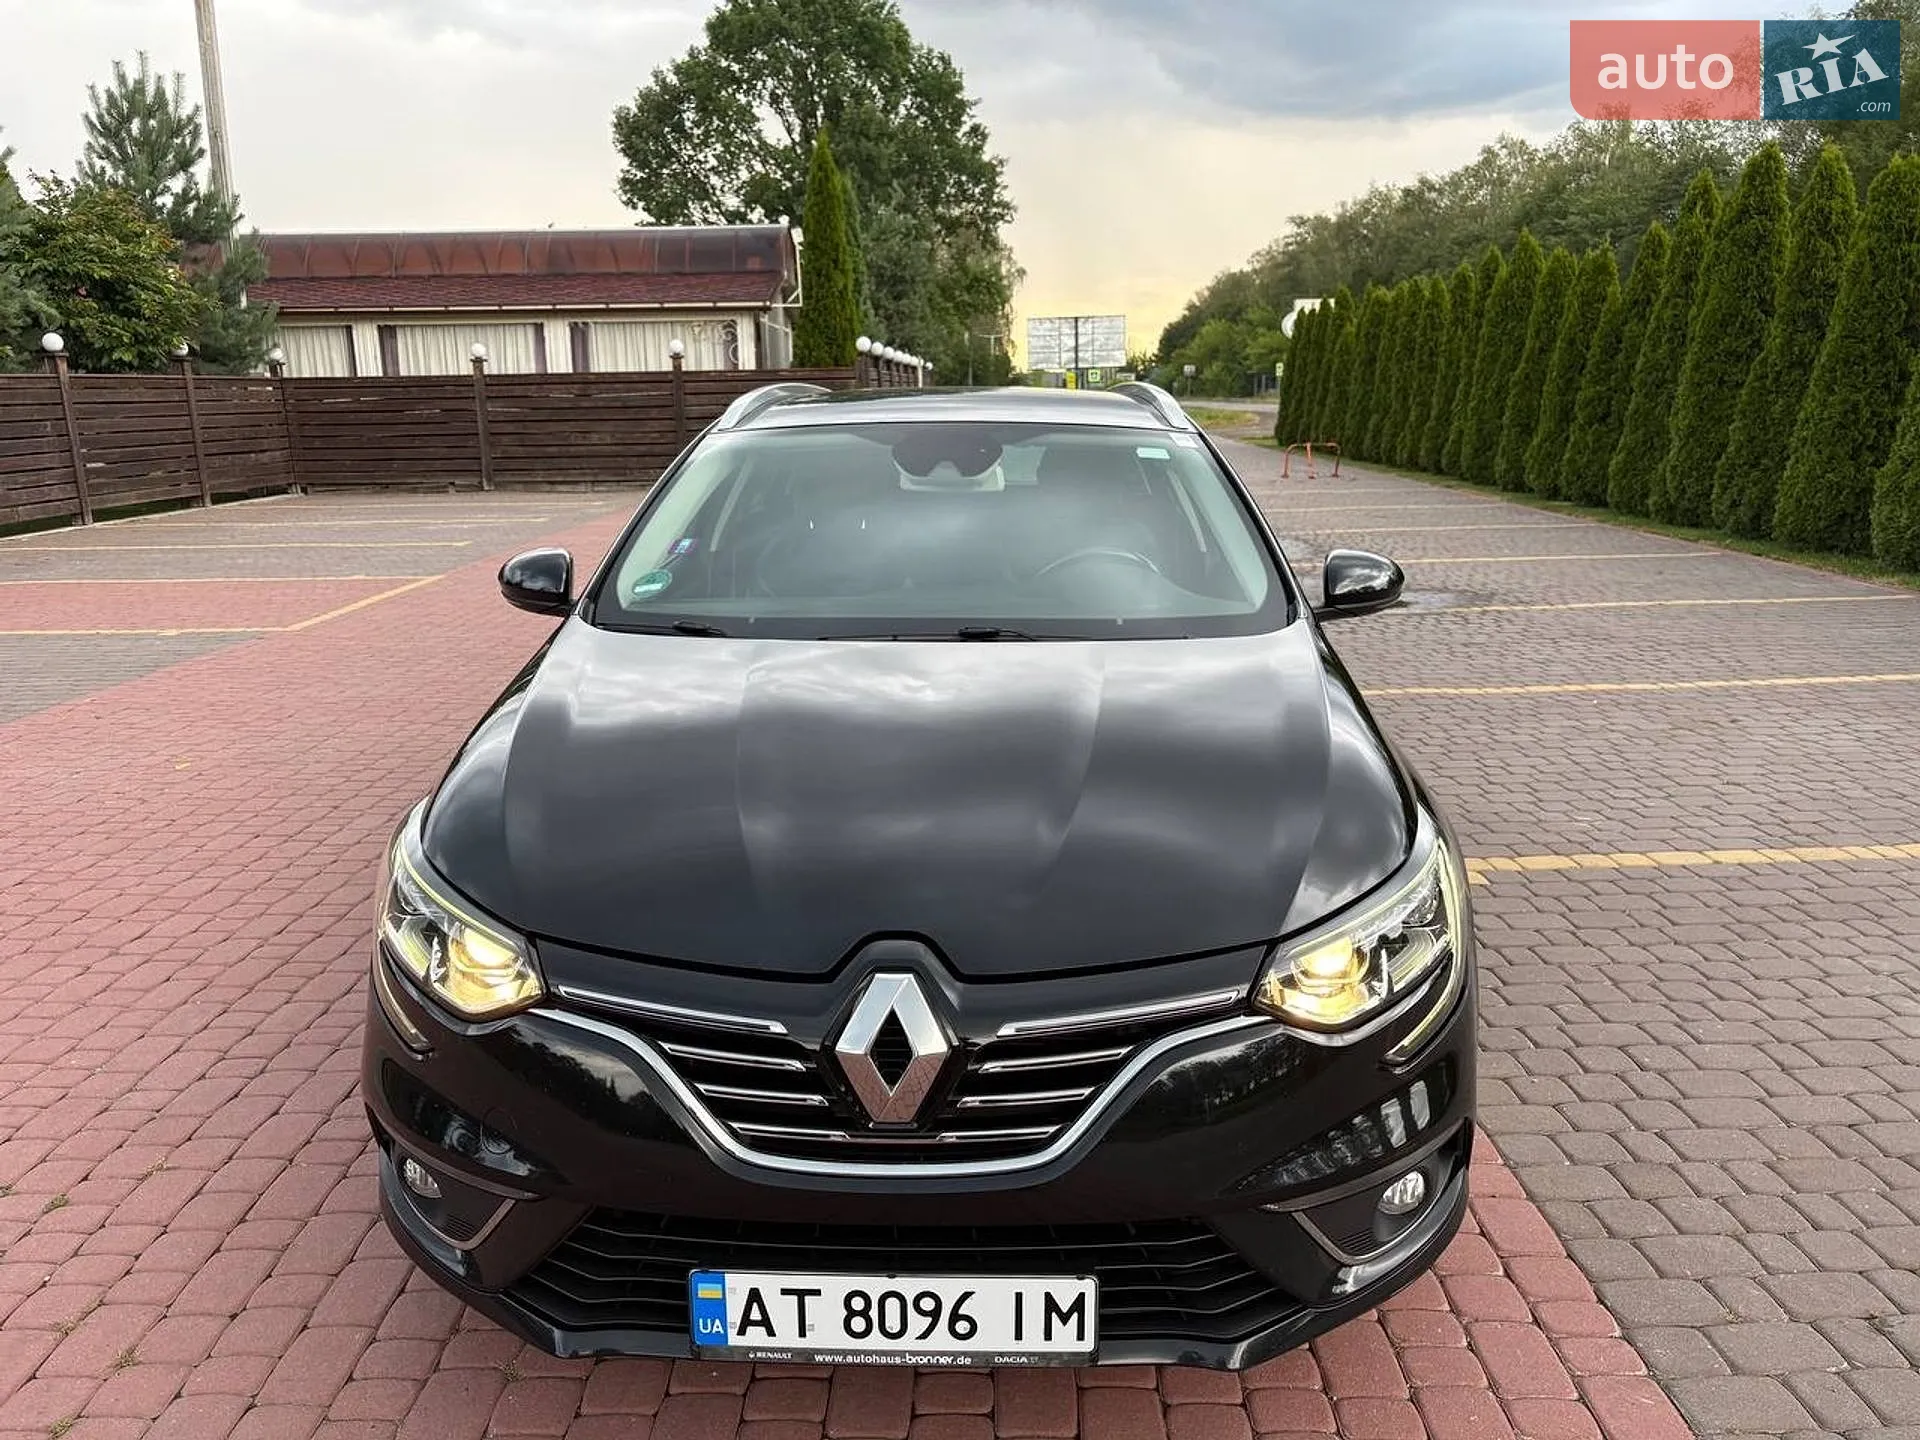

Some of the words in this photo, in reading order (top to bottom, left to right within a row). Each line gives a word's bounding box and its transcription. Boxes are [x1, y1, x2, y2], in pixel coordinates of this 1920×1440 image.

[736, 1287, 822, 1339] AT
[842, 1289, 979, 1342] 8096
[1014, 1291, 1086, 1342] IM
[699, 1318, 724, 1334] UA
[756, 1351, 792, 1359] RENAULT
[814, 1352, 972, 1366] www.autohaus-bronner.de
[994, 1355, 1028, 1364] DACIA
